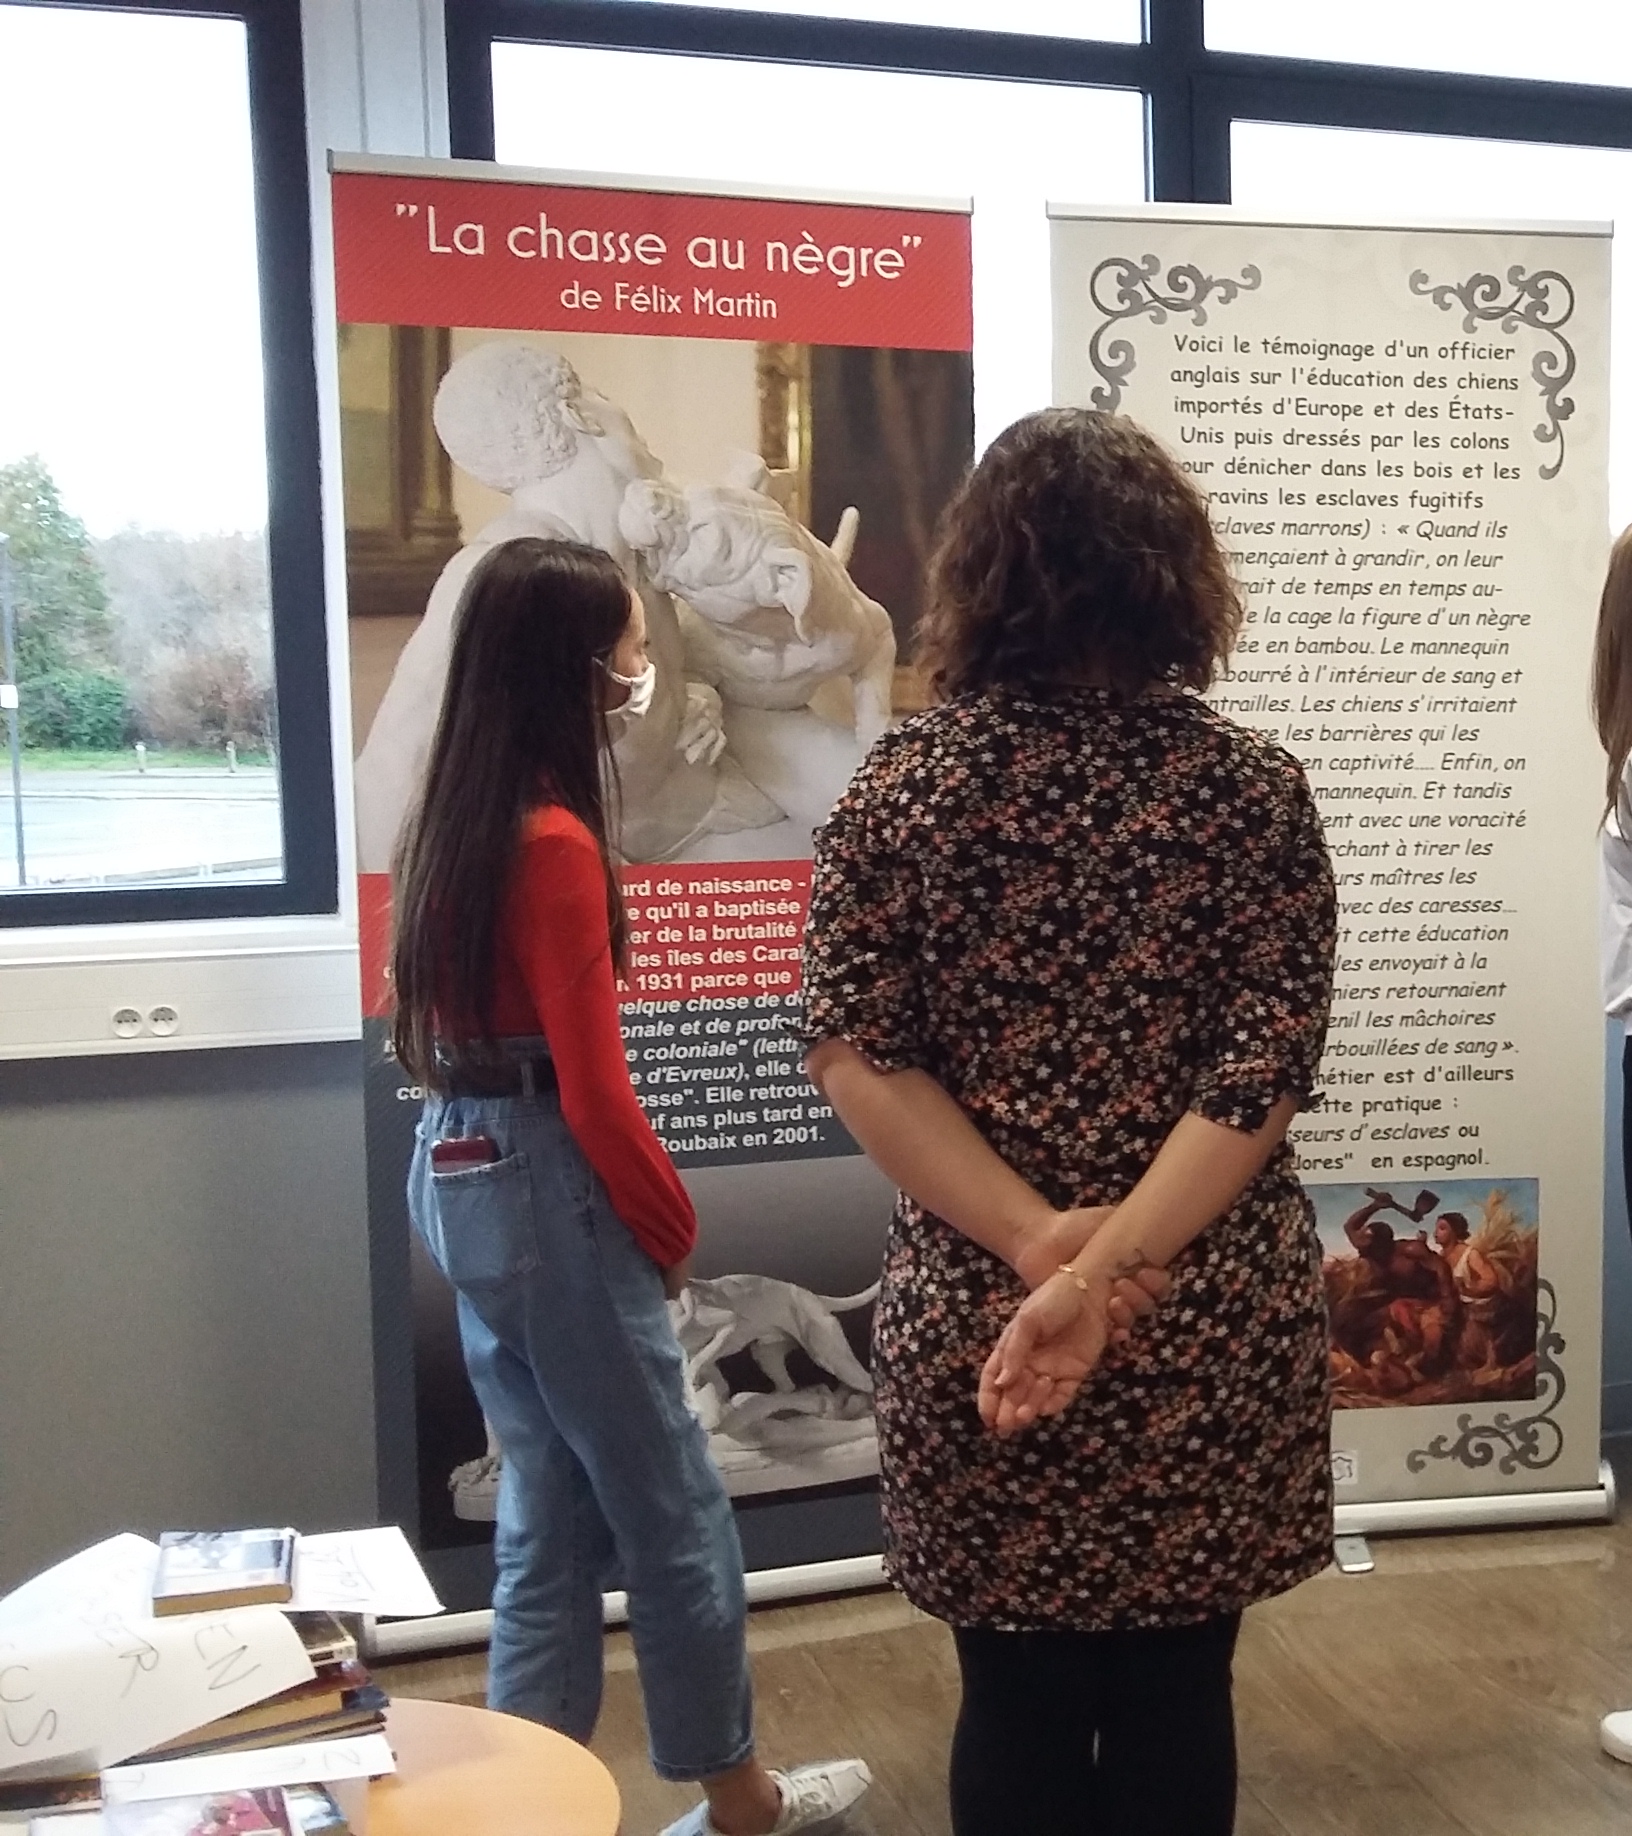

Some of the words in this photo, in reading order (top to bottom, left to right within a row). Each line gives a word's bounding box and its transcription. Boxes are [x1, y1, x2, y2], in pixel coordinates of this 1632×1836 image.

[507, 212, 667, 265] chasse
[687, 237, 744, 270] au
[560, 280, 602, 310] de
[615, 282, 682, 313] Félix
[694, 287, 777, 318] Martin
[1174, 334, 1223, 353] Voici
[1234, 335, 1250, 353] le
[1261, 336, 1374, 362] témoignage
[1385, 340, 1428, 358] d'un
[1438, 341, 1515, 360] officier
[1171, 365, 1240, 388] anglais
[1250, 372, 1282, 384] sur
[1292, 367, 1403, 388] l'éducation
[1413, 371, 1447, 389] des
[1457, 372, 1518, 390] chiens
[1174, 395, 1262, 419] importés
[1273, 397, 1363, 422] d'Europe
[1374, 402, 1395, 417] et
[1405, 400, 1438, 418] des
[1449, 394, 1514, 420] États-
[1181, 426, 1224, 444] Unis
[1235, 428, 1273, 449] puis
[1283, 428, 1360, 447] dressés
[1371, 435, 1403, 452] par
[1414, 430, 1440, 448] les
[1450, 432, 1509, 450] colons
[1224, 456, 1311, 475] dénicher
[1321, 459, 1366, 477] dans
[1377, 460, 1403, 477] les
[1414, 461, 1452, 478] bois
[1462, 464, 1484, 479] et
[1494, 462, 1520, 479] les
[1208, 488, 1269, 505] ravins
[1279, 487, 1306, 505] les
[1316, 489, 1398, 507] esclaves
[1409, 490, 1483, 513] fugitifs
[1281, 518, 1370, 540] marrons)
[1416, 520, 1480, 541] Quand
[1485, 520, 1508, 538] ils
[1351, 548, 1430, 571] grandir,
[1362, 607, 1421, 630] figure
[1427, 607, 1470, 625] d'un
[1476, 608, 1531, 631] nègre
[1294, 636, 1375, 654] bambou.
[1380, 637, 1404, 654] Le
[1410, 639, 1509, 660] mannequin
[1315, 665, 1417, 683] l'intérieur
[1451, 671, 1496, 689] sang
[1300, 695, 1336, 712] Les
[1341, 695, 1403, 712] chiens
[1408, 694, 1518, 713] s'irritaient
[1319, 723, 1413, 741] barrières
[1419, 725, 1447, 746] qui
[1451, 724, 1480, 741] les
[1441, 752, 1498, 772] Enfin,
[1423, 781, 1447, 799] Et
[1453, 782, 1512, 799] tandis
[1359, 815, 1403, 828] avec
[1409, 815, 1441, 828] une
[1448, 809, 1526, 827] voracité
[1414, 840, 1460, 856] tirer
[656, 879, 683, 895] de
[688, 877, 792, 894] naissance
[1370, 867, 1444, 886] maîtres
[646, 902, 690, 924] qu'il
[696, 905, 708, 918] a
[714, 898, 801, 920] baptisée
[657, 926, 683, 943] de
[688, 925, 707, 941] la
[712, 921, 797, 941] brutalité
[1358, 927, 1410, 943] cette
[1416, 924, 1509, 942] éducation
[632, 952, 662, 967] les
[666, 949, 704, 966] îles
[709, 947, 747, 964] des
[1368, 954, 1449, 975] envoyait
[636, 973, 682, 990] 1931
[691, 973, 748, 992] parce
[754, 971, 792, 988] que
[686, 995, 749, 1012] chose
[754, 991, 780, 1008] de
[680, 1020, 701, 1036] et
[705, 1017, 731, 1034] de
[1399, 1009, 1496, 1027] mâchoires
[646, 1062, 750, 1084] d'Evreux),
[755, 1060, 791, 1077] elle
[1424, 1064, 1514, 1082] d'ailleurs
[706, 1086, 744, 1103] Elle
[670, 1113, 708, 1129] ans
[714, 1109, 757, 1130] plus
[762, 1104, 803, 1122] tard
[808, 1106, 832, 1119] en
[1362, 1096, 1442, 1117] pratique
[657, 1132, 737, 1153] Roubaix
[742, 1133, 767, 1147] en
[773, 1126, 825, 1144] 2001.
[1350, 1123, 1450, 1141] d'esclaves
[1402, 1148, 1489, 1172] espagnol.
